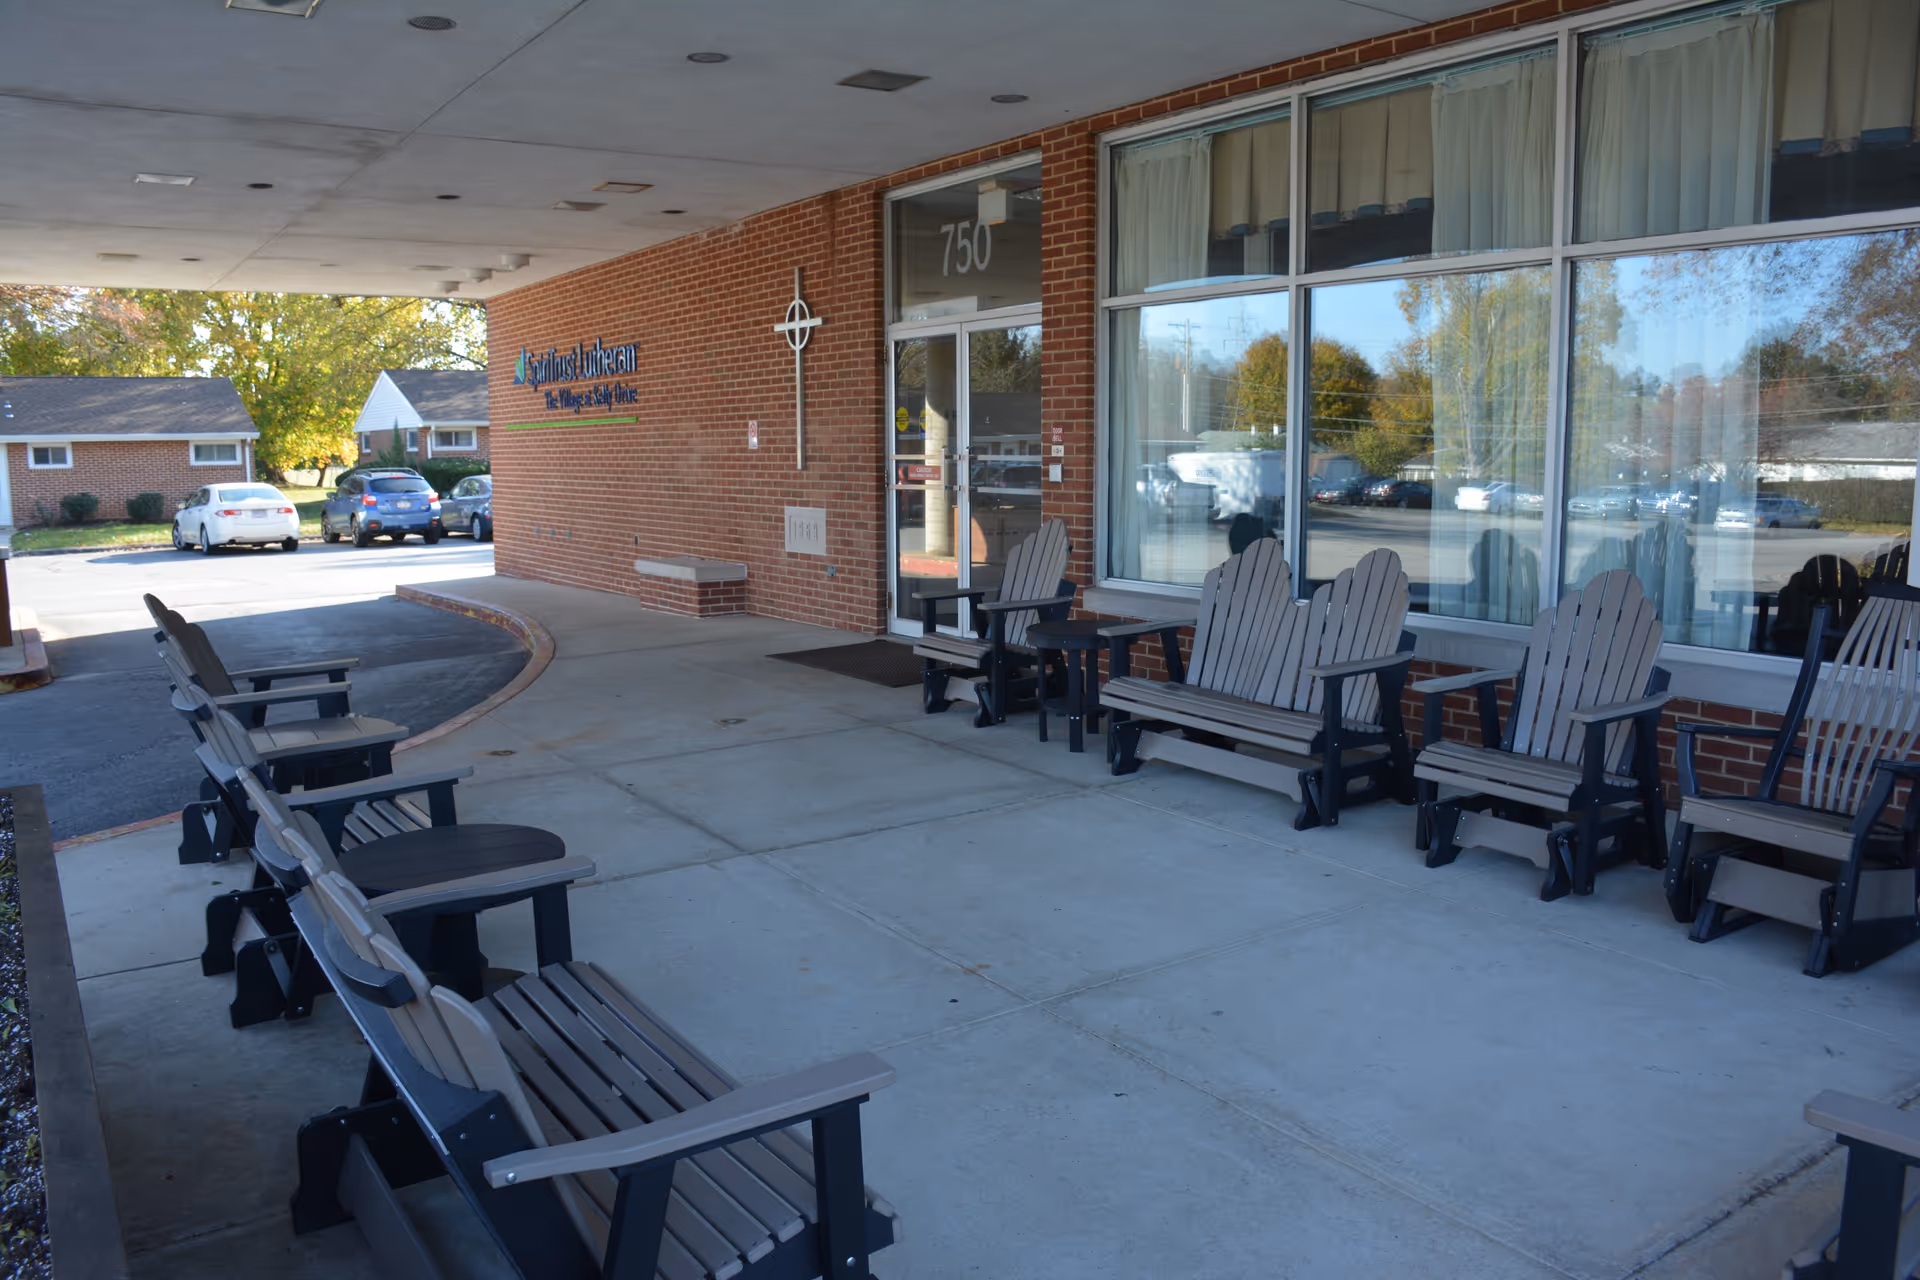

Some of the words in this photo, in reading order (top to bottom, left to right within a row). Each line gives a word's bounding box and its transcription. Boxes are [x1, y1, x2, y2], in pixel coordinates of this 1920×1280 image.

[940, 219, 992, 277] 750
[527, 346, 577, 392] SpiriTrust
[578, 337, 637, 379] Lutheran
[545, 390, 557, 409] The
[558, 388, 583, 414] Village
[593, 384, 612, 412] Kelly
[614, 382, 638, 404] Drive
